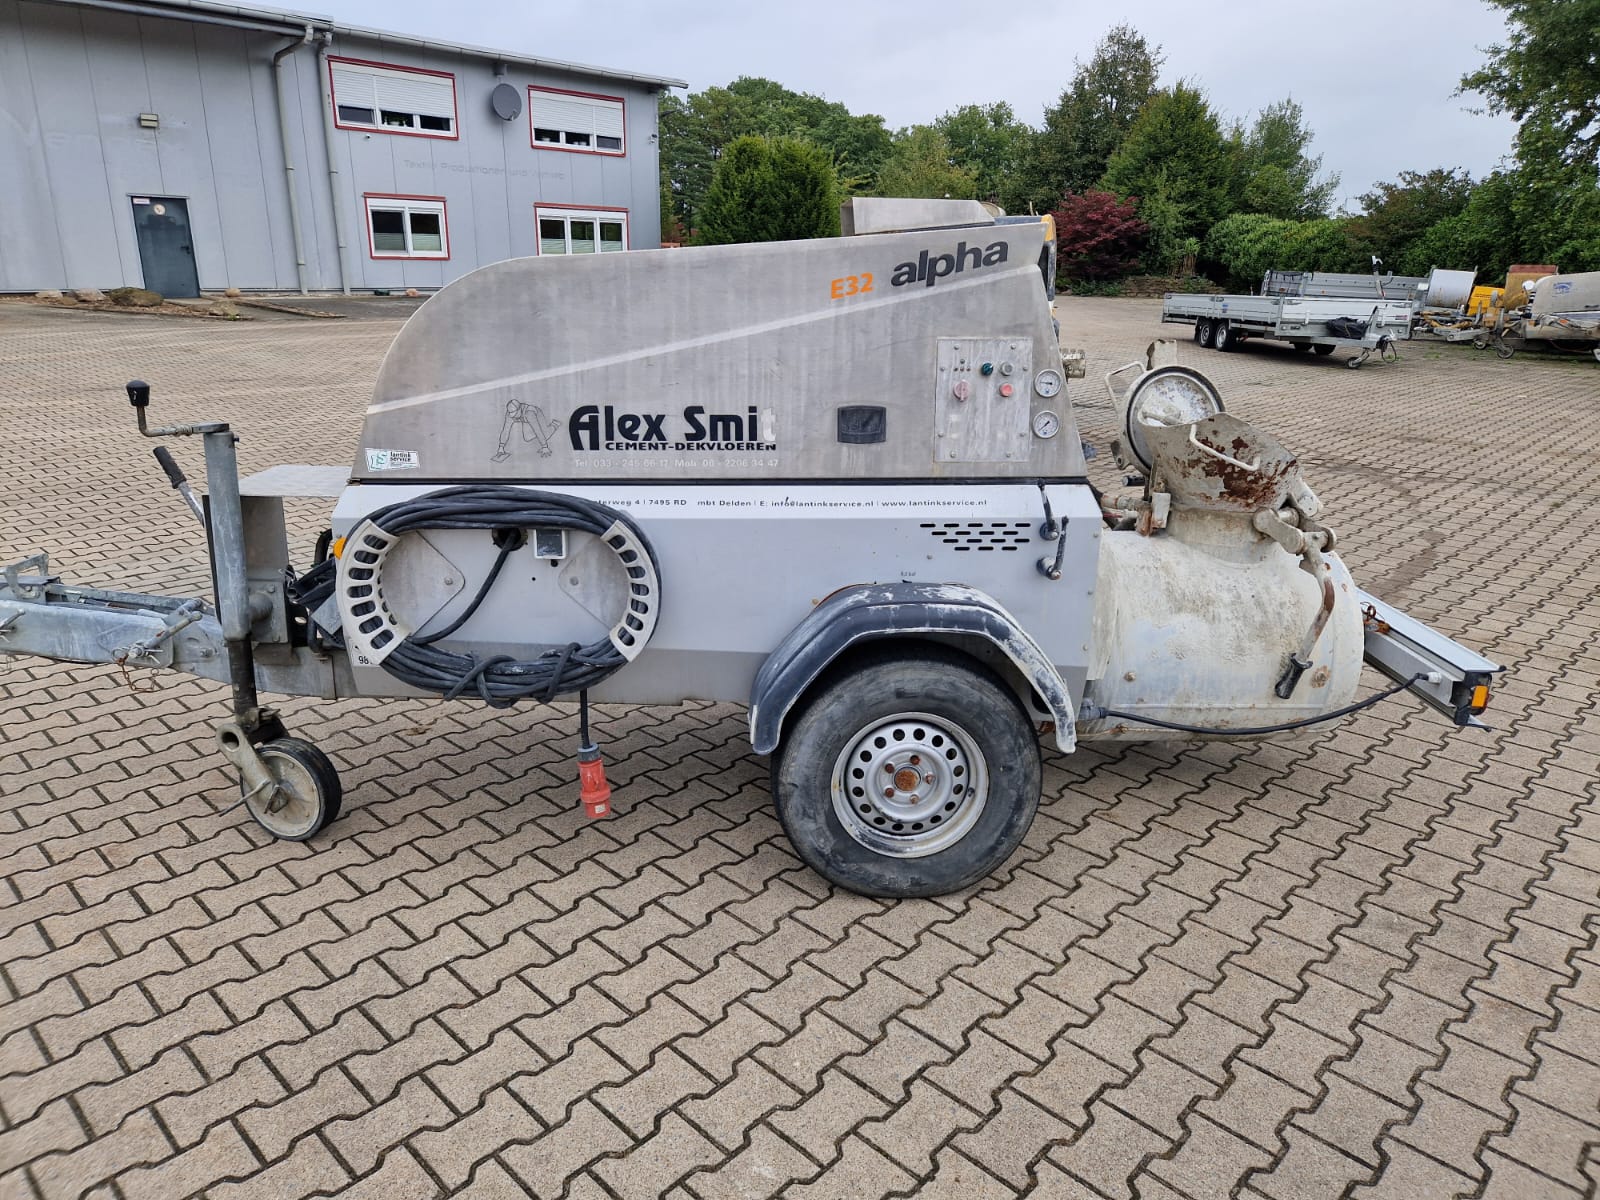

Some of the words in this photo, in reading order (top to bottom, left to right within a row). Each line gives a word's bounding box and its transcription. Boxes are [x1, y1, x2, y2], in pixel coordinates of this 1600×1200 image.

[890, 240, 1009, 288] alpha
[830, 272, 874, 300] E32
[568, 405, 667, 450] Alex
[683, 405, 776, 442] Smit
[605, 442, 776, 451] CEMENT-DEKVLOEREN
[598, 499, 632, 507] terweg
[719, 499, 752, 507] Delden
[881, 499, 987, 507] www.lantinkservice.nl
